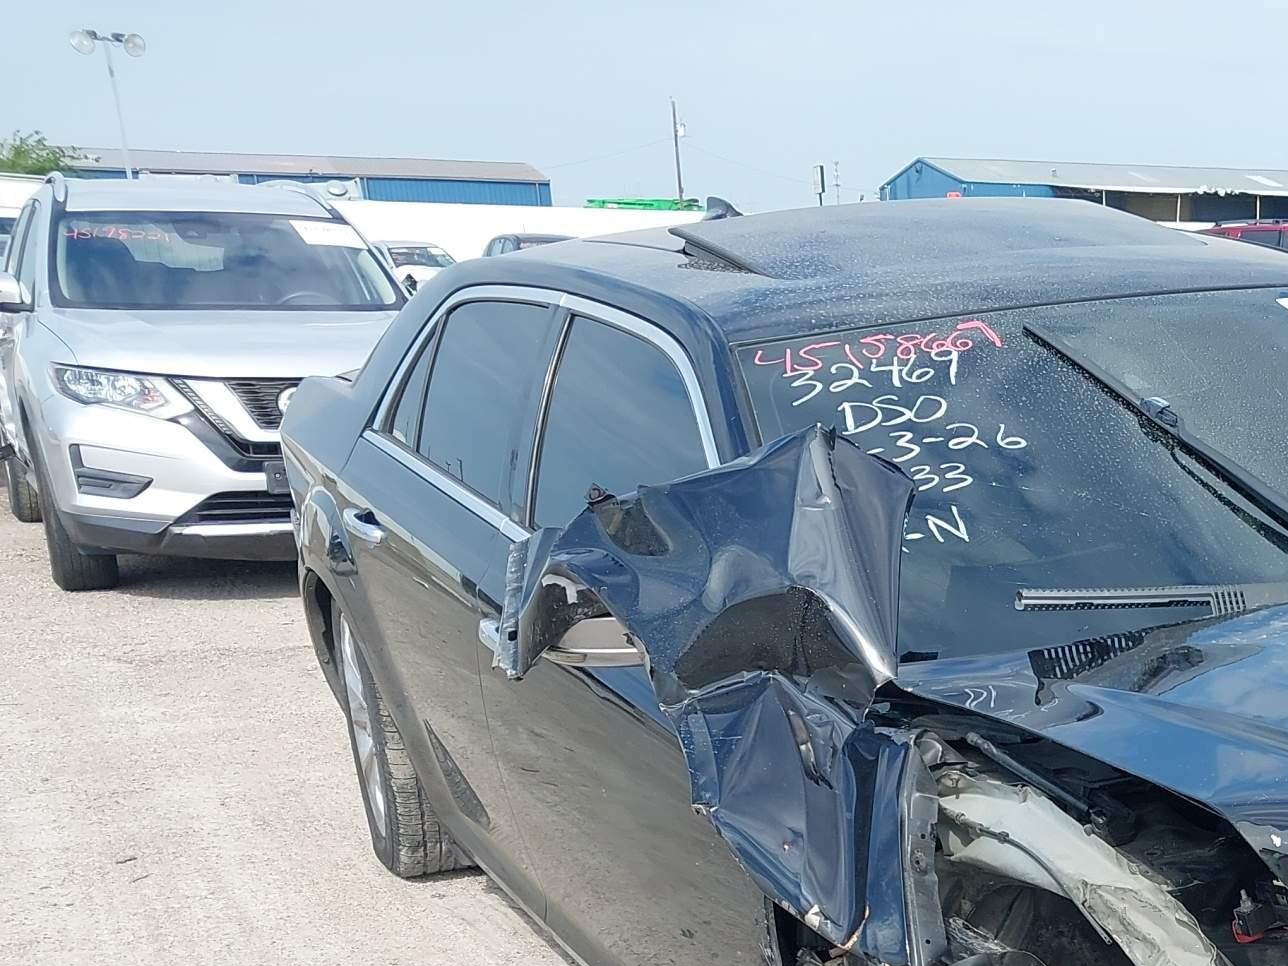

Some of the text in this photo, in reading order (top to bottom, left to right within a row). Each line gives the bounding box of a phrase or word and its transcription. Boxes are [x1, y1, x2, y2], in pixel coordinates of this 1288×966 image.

[754, 320, 1003, 375] 45158667
[783, 347, 959, 406] 32469
[866, 423, 1028, 462] -3-26
